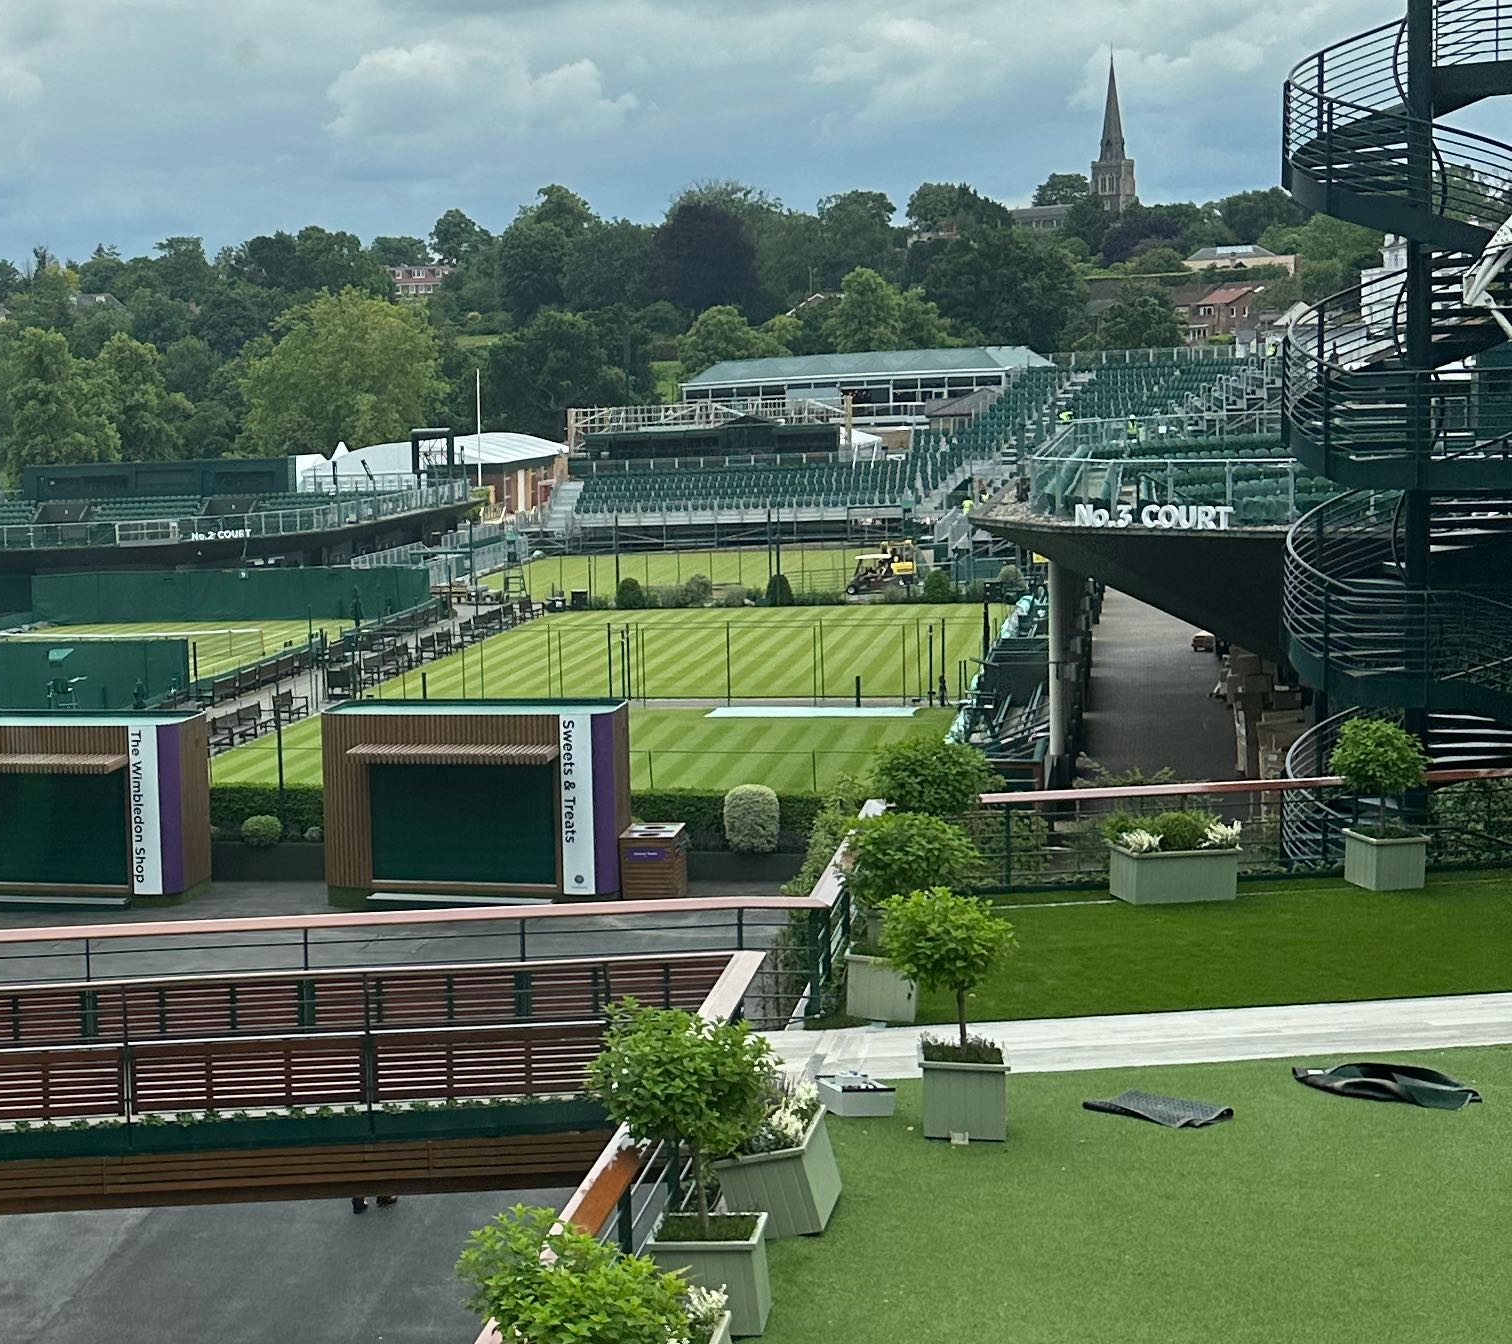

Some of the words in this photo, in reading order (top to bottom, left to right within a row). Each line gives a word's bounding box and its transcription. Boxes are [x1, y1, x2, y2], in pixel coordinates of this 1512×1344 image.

[1074, 503, 1133, 528] No.3
[1141, 504, 1234, 531] COURT
[191, 530, 217, 542] No.2
[217, 528, 252, 540] COURT
[130, 729, 142, 757] The
[562, 719, 575, 777] Sweets
[563, 780, 577, 791] &
[131, 760, 145, 844] Wimbledon
[564, 796, 577, 844] Treats
[134, 847, 147, 884] Shop
